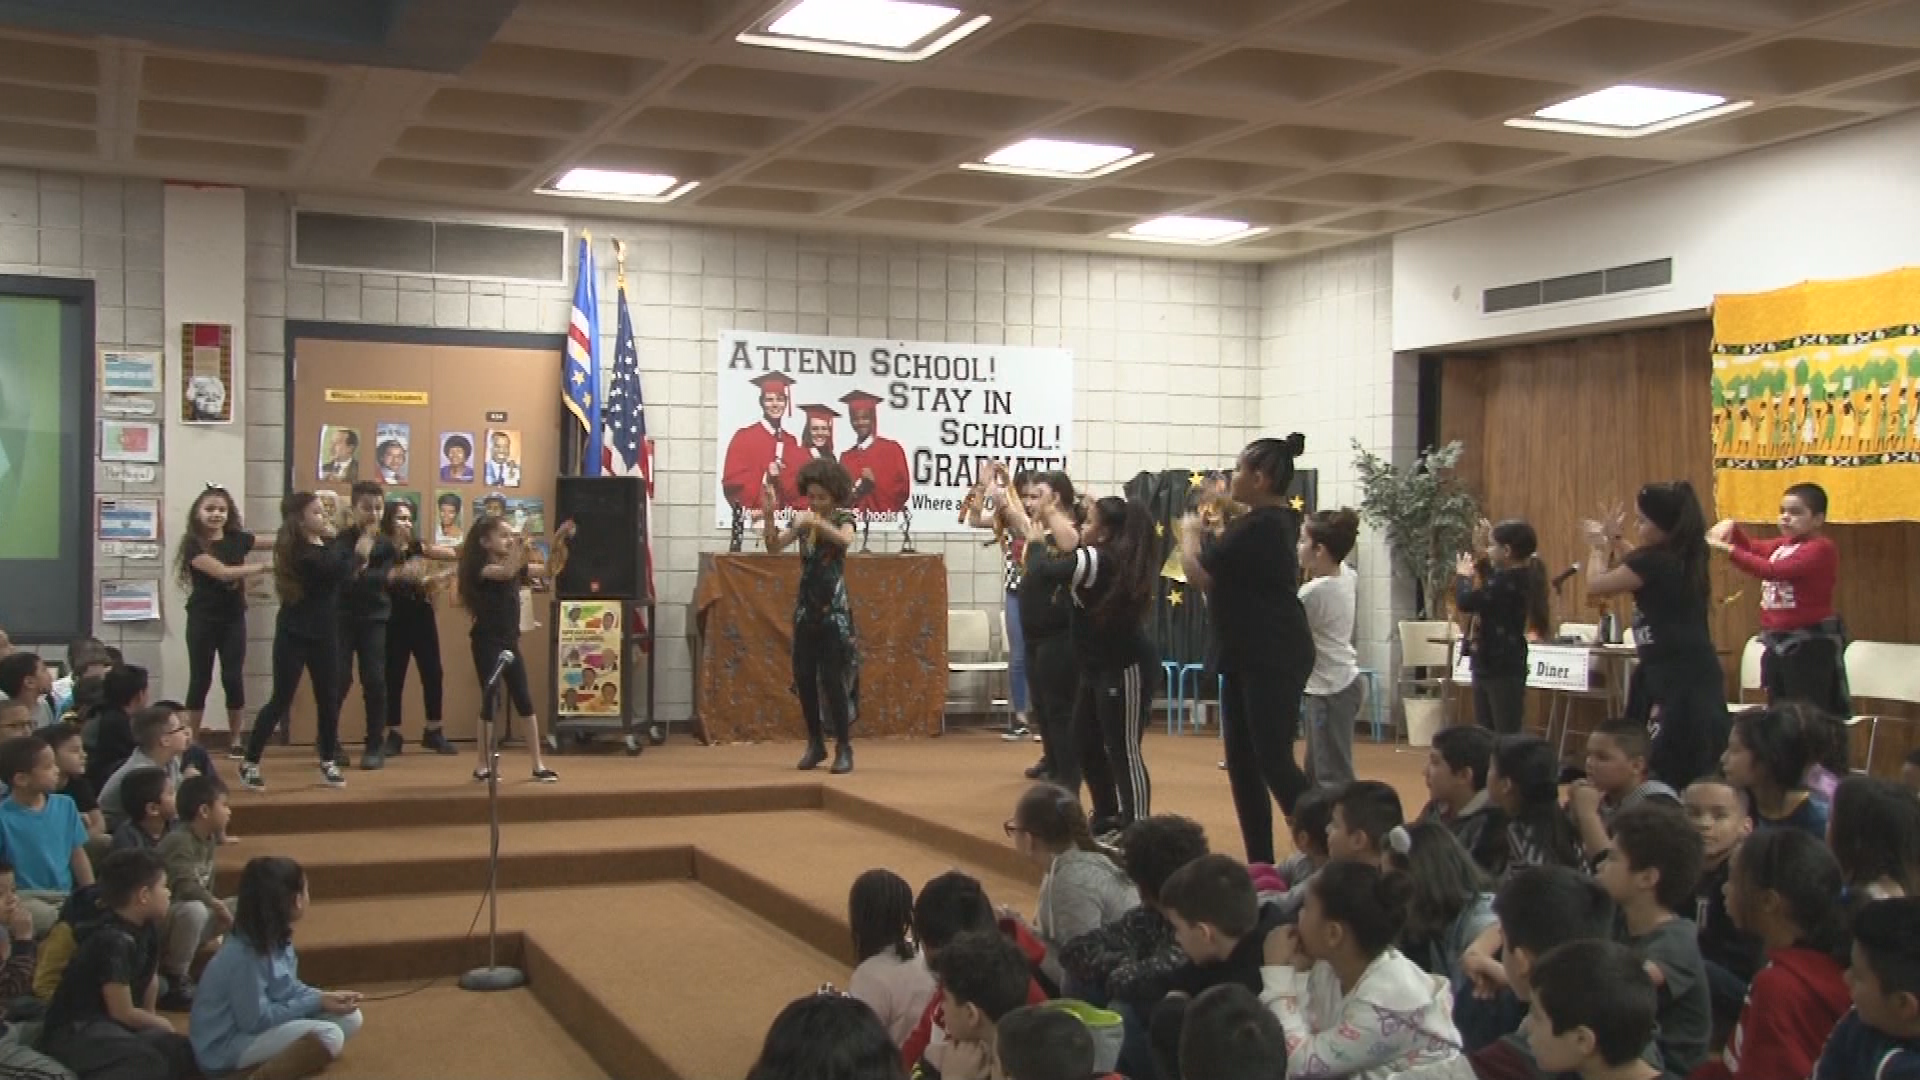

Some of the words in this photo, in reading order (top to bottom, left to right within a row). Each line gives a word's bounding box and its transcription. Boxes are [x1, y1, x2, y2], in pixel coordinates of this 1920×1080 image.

[729, 341, 856, 376] ATTEND
[871, 348, 994, 382] SCHOOL!
[889, 381, 972, 413] STAY
[984, 389, 1012, 415] IN
[940, 418, 1060, 451] SCHOOL!
[912, 494, 953, 511] Where
[1536, 661, 1570, 679] Diner
